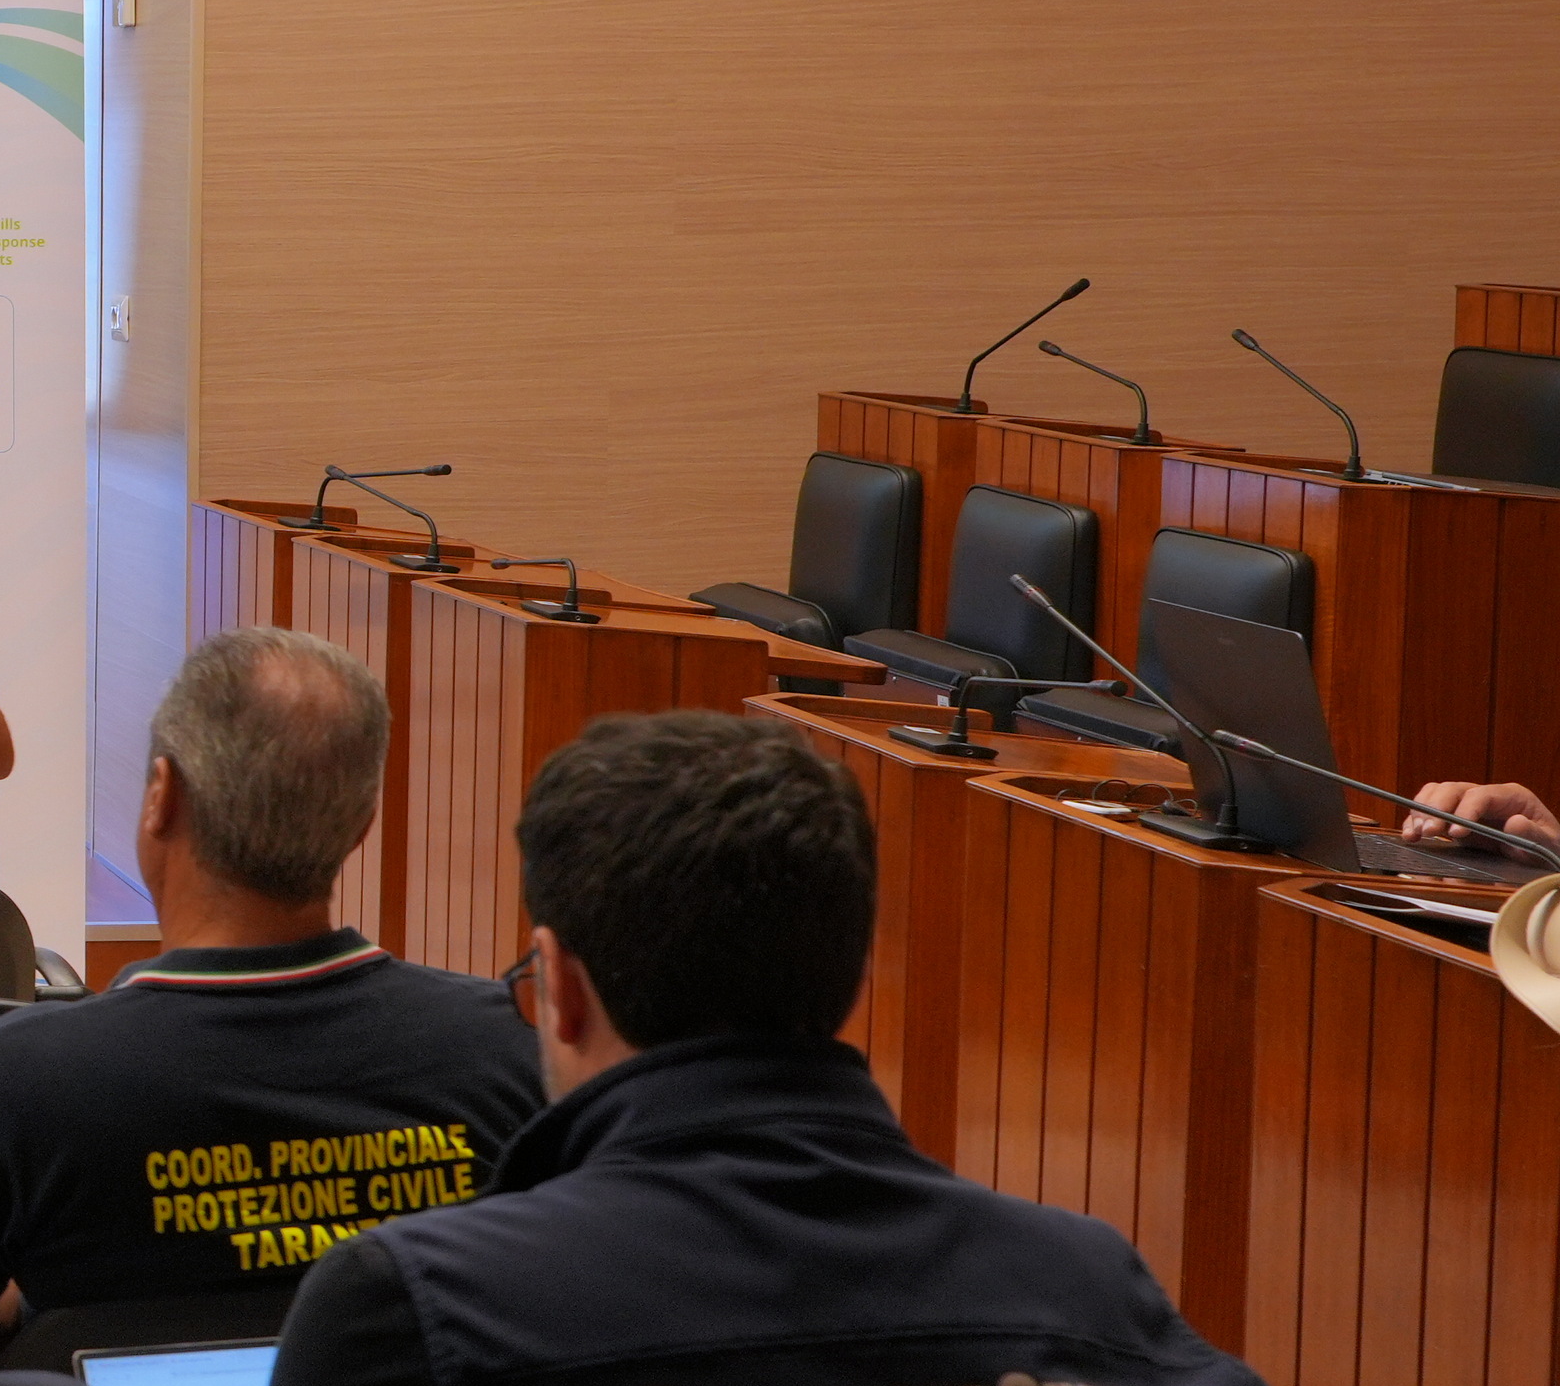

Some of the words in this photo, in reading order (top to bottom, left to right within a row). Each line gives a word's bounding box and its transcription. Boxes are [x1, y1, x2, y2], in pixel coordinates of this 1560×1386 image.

[146, 1143, 263, 1190] COORD.
[270, 1123, 475, 1178] PROVINCIALE
[152, 1177, 359, 1235] PROTEZIONE
[367, 1162, 476, 1212] CIVILE
